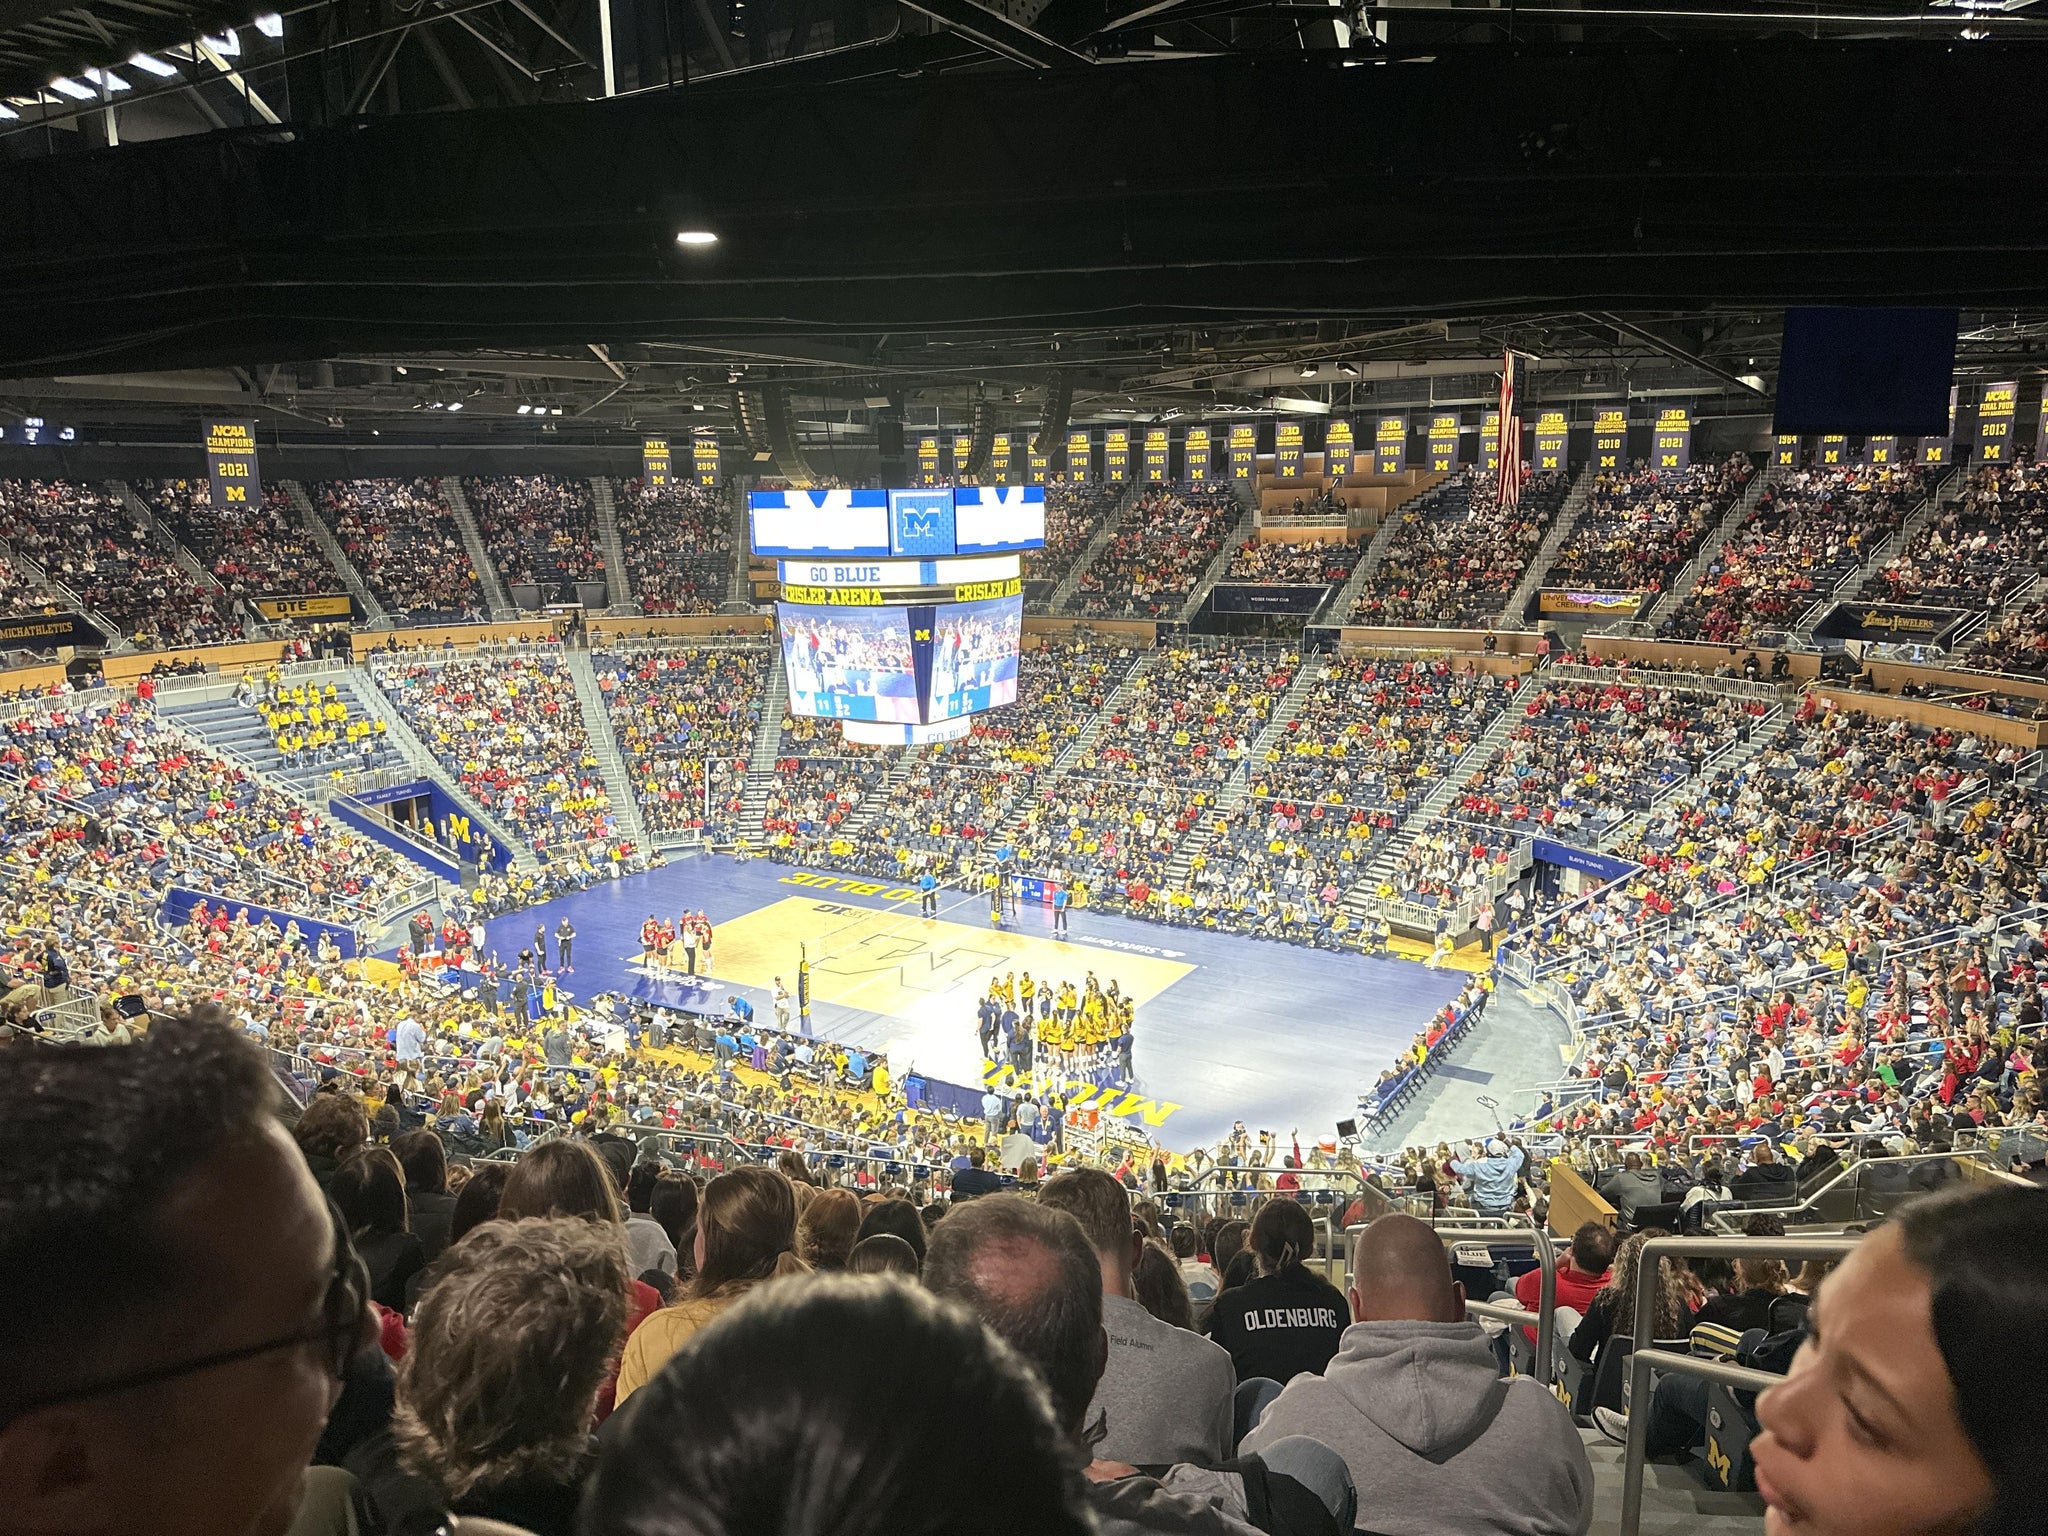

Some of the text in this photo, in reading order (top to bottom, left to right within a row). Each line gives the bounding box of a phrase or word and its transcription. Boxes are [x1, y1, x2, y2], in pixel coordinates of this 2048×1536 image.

[1985, 390, 2011, 401] NCAA
[212, 425, 246, 437] NCAA
[1982, 423, 2006, 436] 2013
[207, 436, 254, 448] CHAMPIONS
[1540, 440, 1562, 450] 2017
[1598, 439, 1620, 449] 2018
[1660, 437, 1683, 448] 2021
[1330, 448, 1349, 458] 1985
[1380, 446, 1400, 456] 1986
[1432, 444, 1452, 454] 2012
[1926, 448, 1942, 461] M
[1984, 445, 2000, 459] M
[1189, 455, 1206, 463] 1966
[1234, 453, 1251, 462] 1974
[1280, 451, 1299, 460] 1977
[1662, 455, 1678, 466] M
[1780, 452, 1793, 464] M
[1825, 451, 1838, 463] M
[1873, 449, 1887, 462] M
[697, 462, 716, 470] 2004
[1382, 462, 1396, 472] M
[1435, 460, 1448, 470] M
[1542, 457, 1557, 468] M
[1600, 456, 1616, 467] M
[218, 462, 249, 477] 2021
[1150, 470, 1161, 479] M
[1192, 470, 1203, 479] M
[1236, 468, 1248, 477] M
[1283, 466, 1295, 476] M
[1332, 464, 1345, 474] M
[652, 476, 664, 484] M
[701, 476, 714, 484] M
[924, 475, 934, 483] M
[996, 473, 1005, 482] M
[1034, 472, 1044, 481] M
[1074, 471, 1084, 481] M
[1112, 470, 1122, 480] M
[226, 486, 246, 501] M
[811, 567, 880, 582] GO BLUE
[786, 585, 826, 604] CRISLER
[828, 588, 884, 605] ARENA
[955, 581, 1004, 602] CRISLER
[276, 601, 307, 612] DTE
[915, 630, 931, 641] M
[449, 813, 471, 843] M
[1586, 860, 1604, 870] TUNNEL
[779, 872, 890, 896] BLUE
[1244, 1307, 1337, 1331] OLDENBURG
[1110, 1335, 1127, 1346] Field
[1708, 1435, 1731, 1487] M
